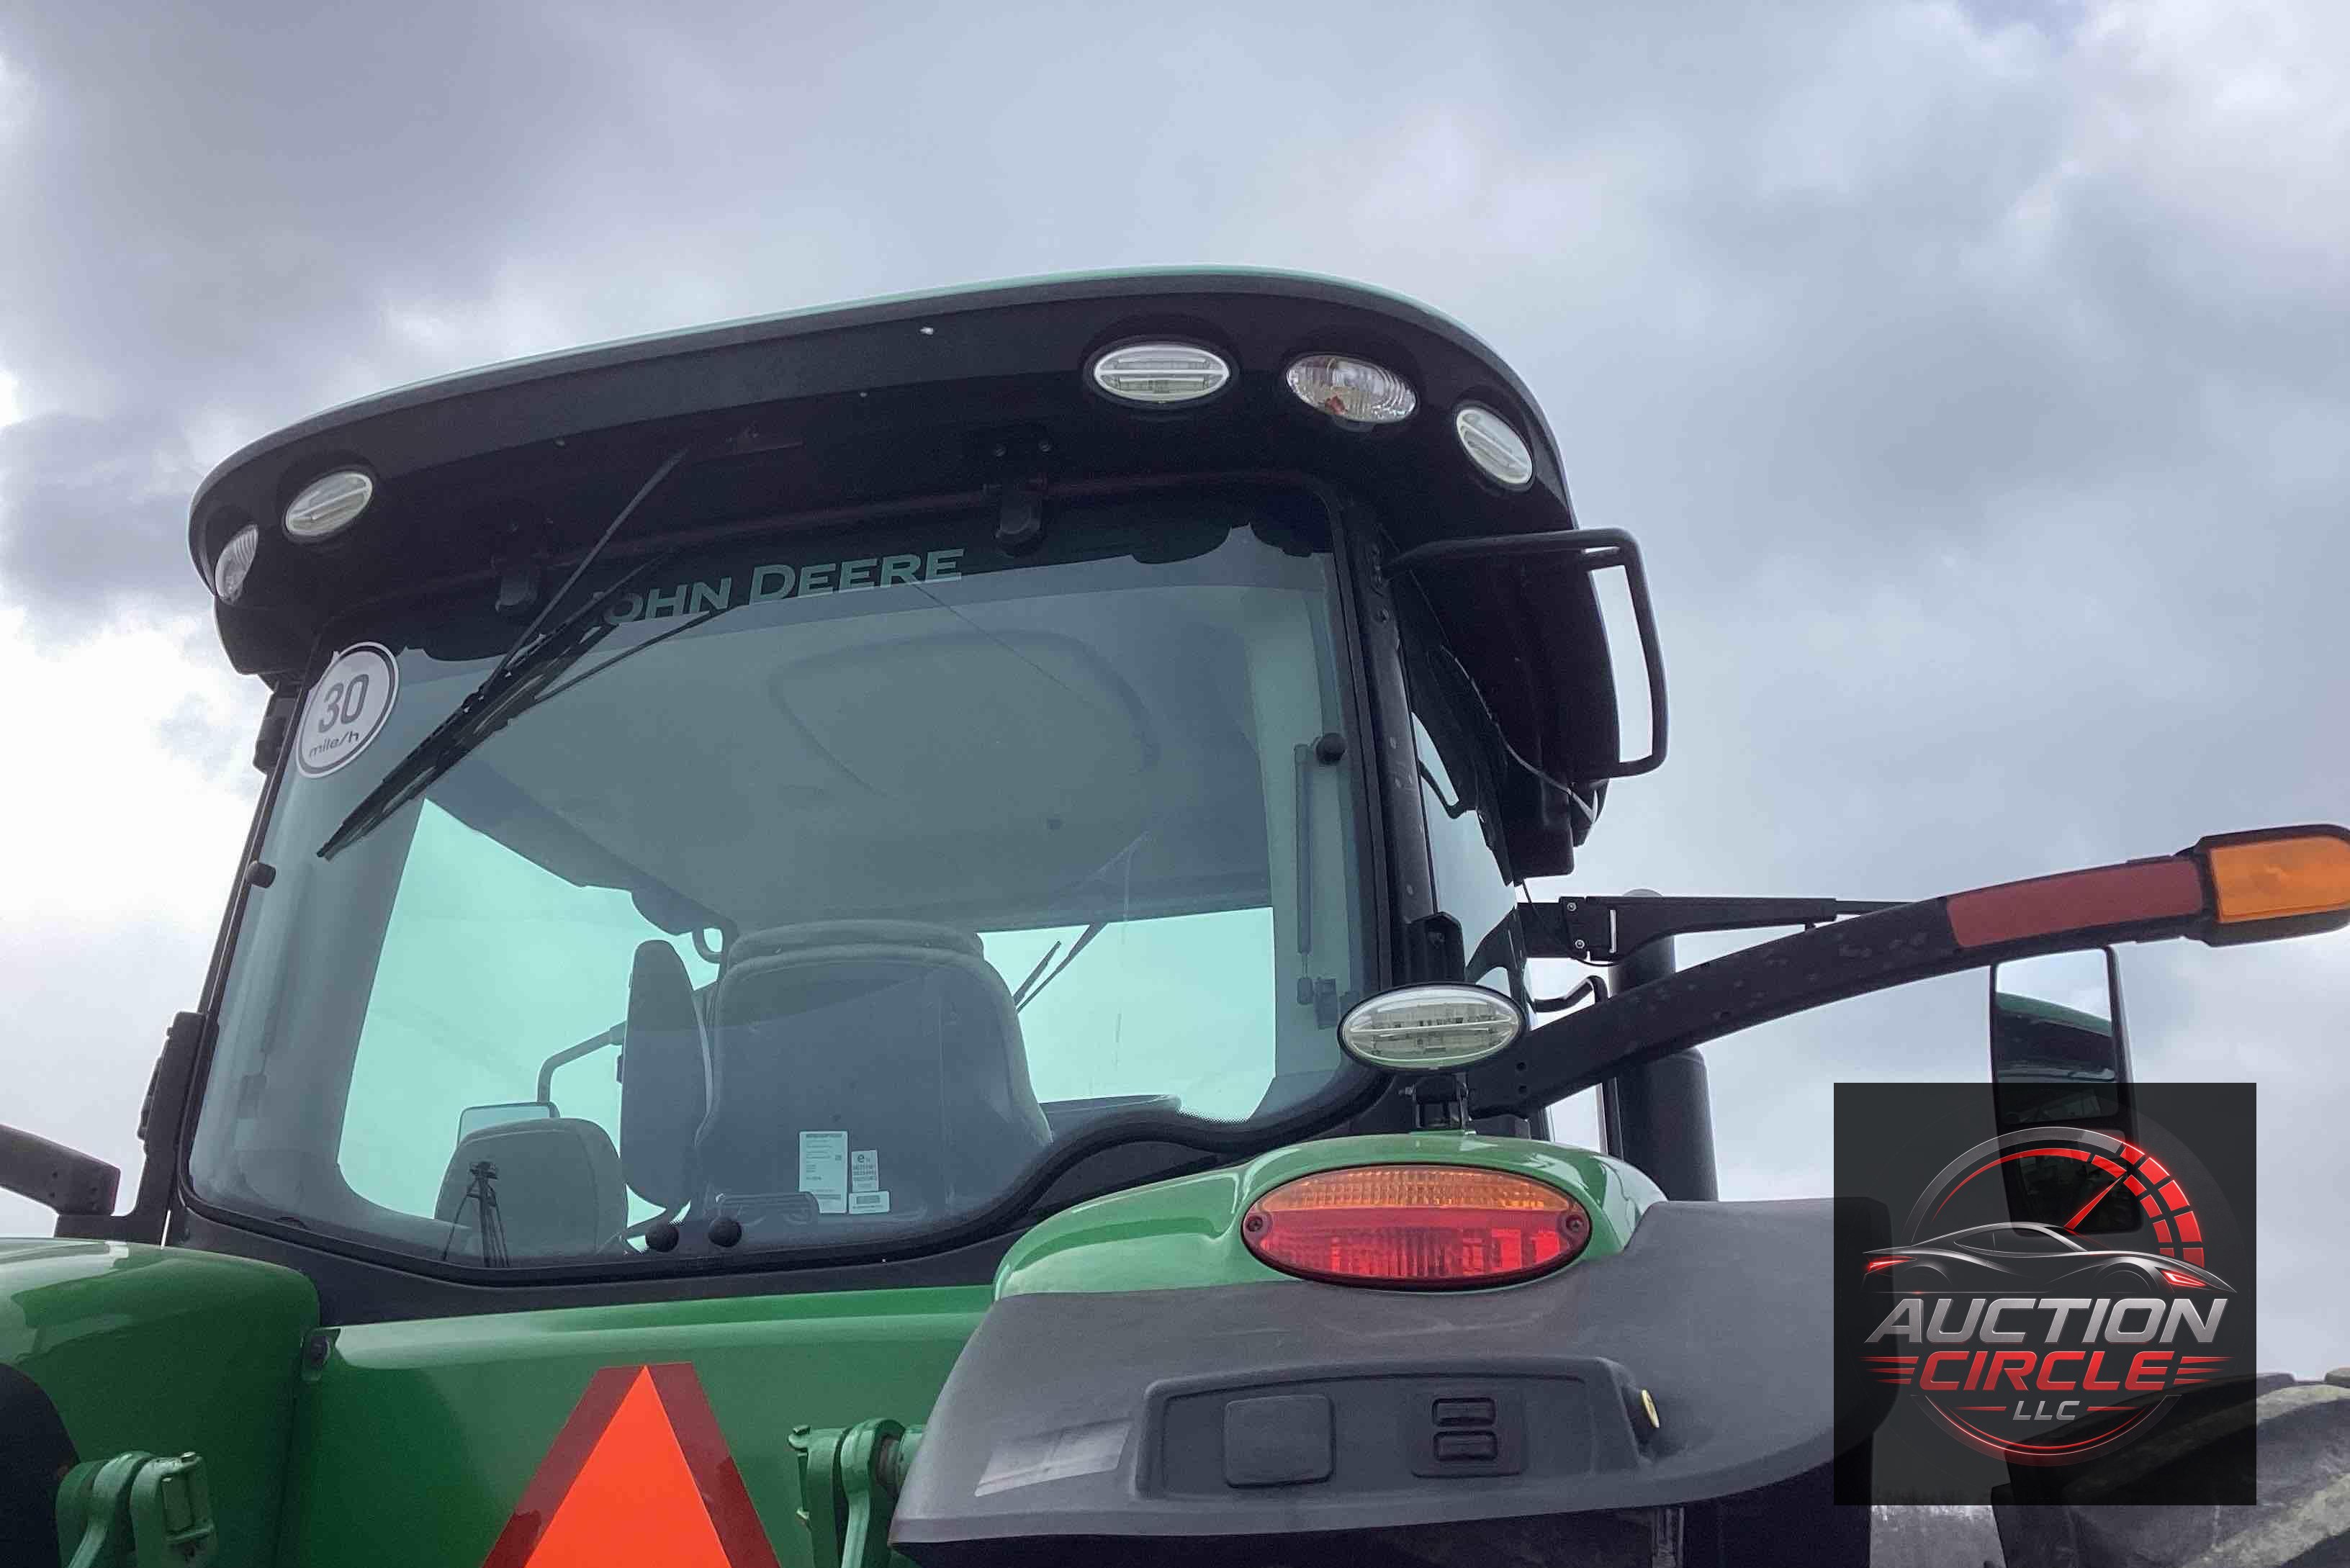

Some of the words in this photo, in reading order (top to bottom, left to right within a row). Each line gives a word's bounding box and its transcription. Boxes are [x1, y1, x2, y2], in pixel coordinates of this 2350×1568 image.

[590, 577, 732, 625] OHN
[749, 549, 965, 605] DEERE
[318, 674, 369, 734] 30
[309, 731, 359, 758] mile/h
